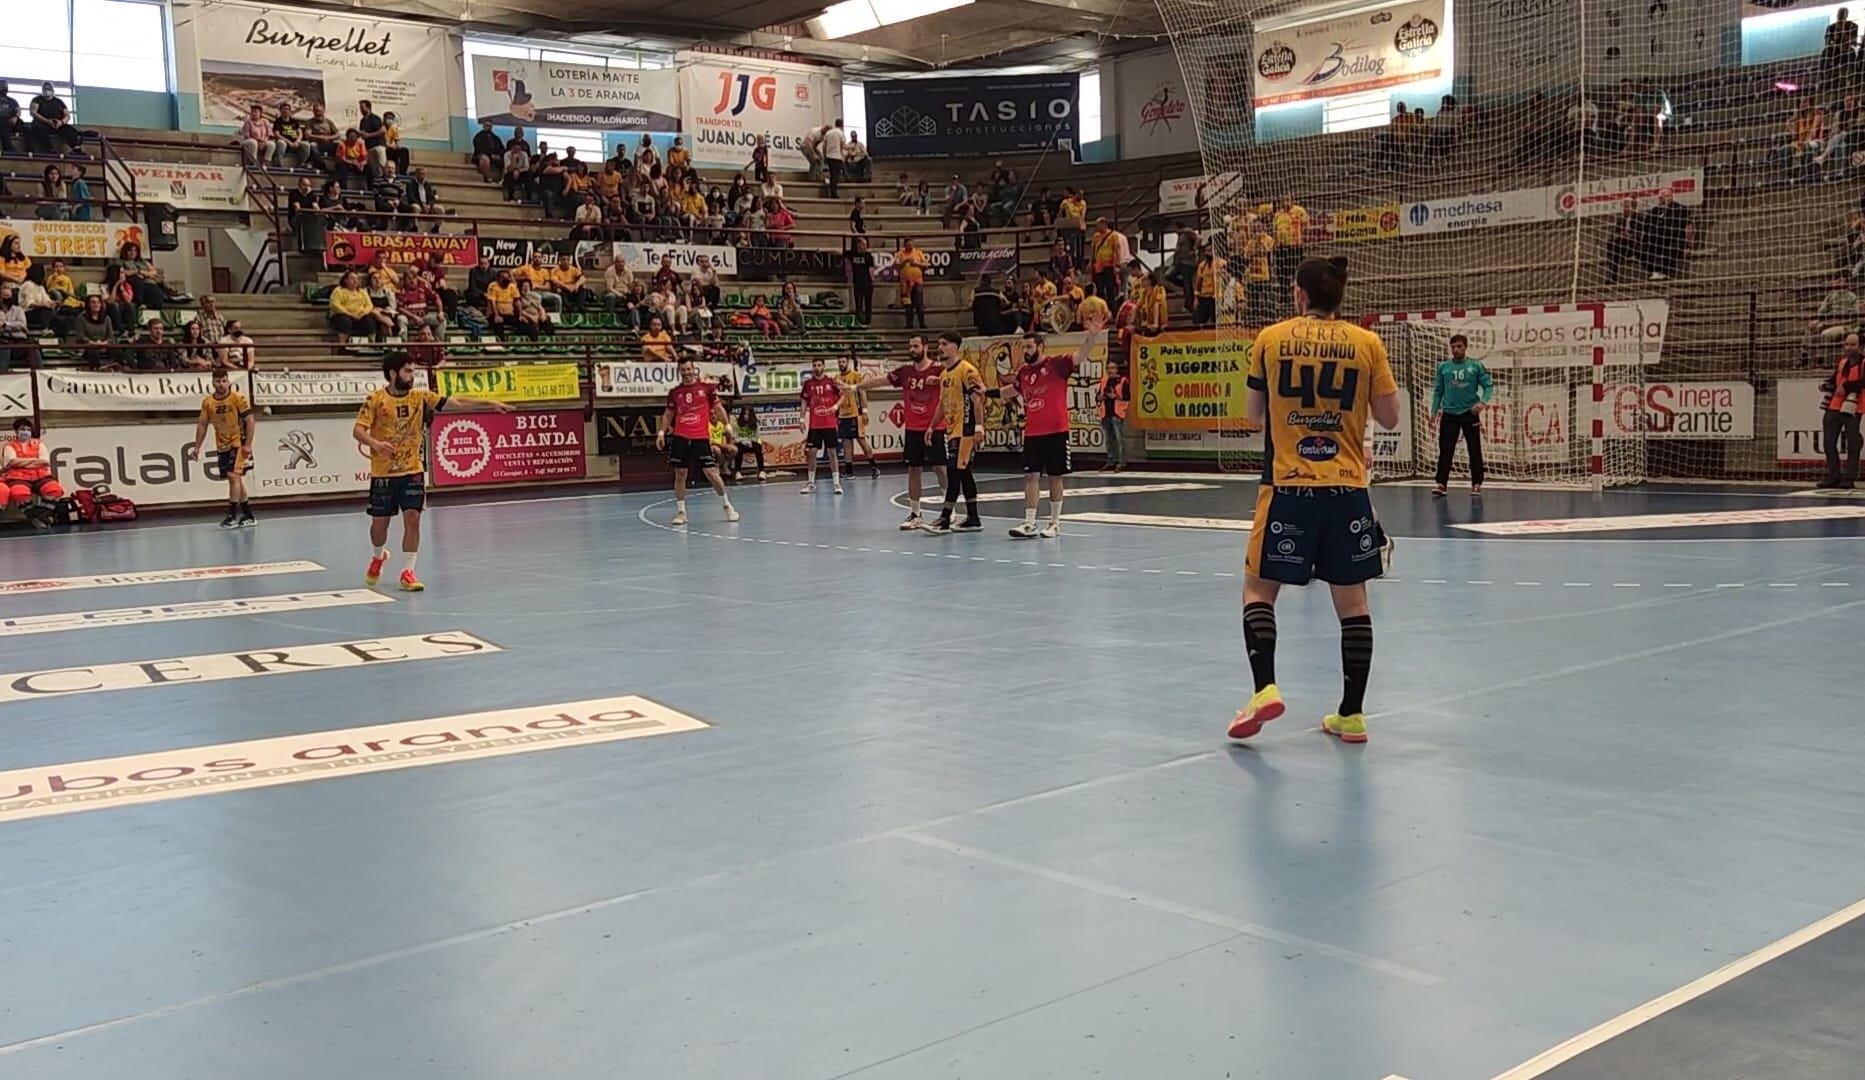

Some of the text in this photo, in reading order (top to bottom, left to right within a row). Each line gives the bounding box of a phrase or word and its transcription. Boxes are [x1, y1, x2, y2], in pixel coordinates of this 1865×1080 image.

[246, 19, 391, 57] Burpellet
[1398, 24, 1435, 40] Estrella
[1399, 36, 1433, 51] Galicia
[360, 60, 400, 72] Natural
[1261, 51, 1293, 65] Estrella
[1262, 63, 1292, 76] Galicia
[550, 69, 640, 87] LOTERÍA MAYTE
[551, 88, 641, 102] LA 3 DE ARANDA
[714, 71, 776, 117] JJG
[945, 99, 1071, 122] TASIO
[696, 116, 742, 129] TRANSPORTES
[946, 123, 1071, 136] construcciones
[697, 129, 735, 146] JUAN
[738, 131, 770, 149] JOÉ
[130, 168, 224, 182] WEIMAR
[1432, 200, 1502, 219] medhesa
[33, 222, 107, 235] FRUTOS SECOS
[33, 236, 108, 256] STREET
[362, 235, 469, 252] BRASA-AWAY
[496, 239, 517, 251] New
[483, 246, 523, 266] Prado
[1279, 341, 1356, 360] ELUSTONDO
[910, 376, 924, 391] 34
[1452, 370, 1465, 382] 16
[47, 375, 149, 396] Carmelo
[256, 380, 377, 396] MONTOUTO
[815, 384, 824, 397] 11
[1278, 359, 1360, 412] 44
[685, 392, 694, 404] 8
[1679, 384, 1733, 408] inera
[396, 404, 410, 419] 13
[515, 414, 558, 430] BICI
[453, 436, 473, 445] BICI
[494, 431, 579, 449] ARANDA
[443, 446, 483, 456] ARANDA
[504, 459, 525, 467] VENTA
[262, 473, 343, 489] PEUGEOT
[11, 633, 484, 694] CERES
[294, 708, 648, 760] aranda
